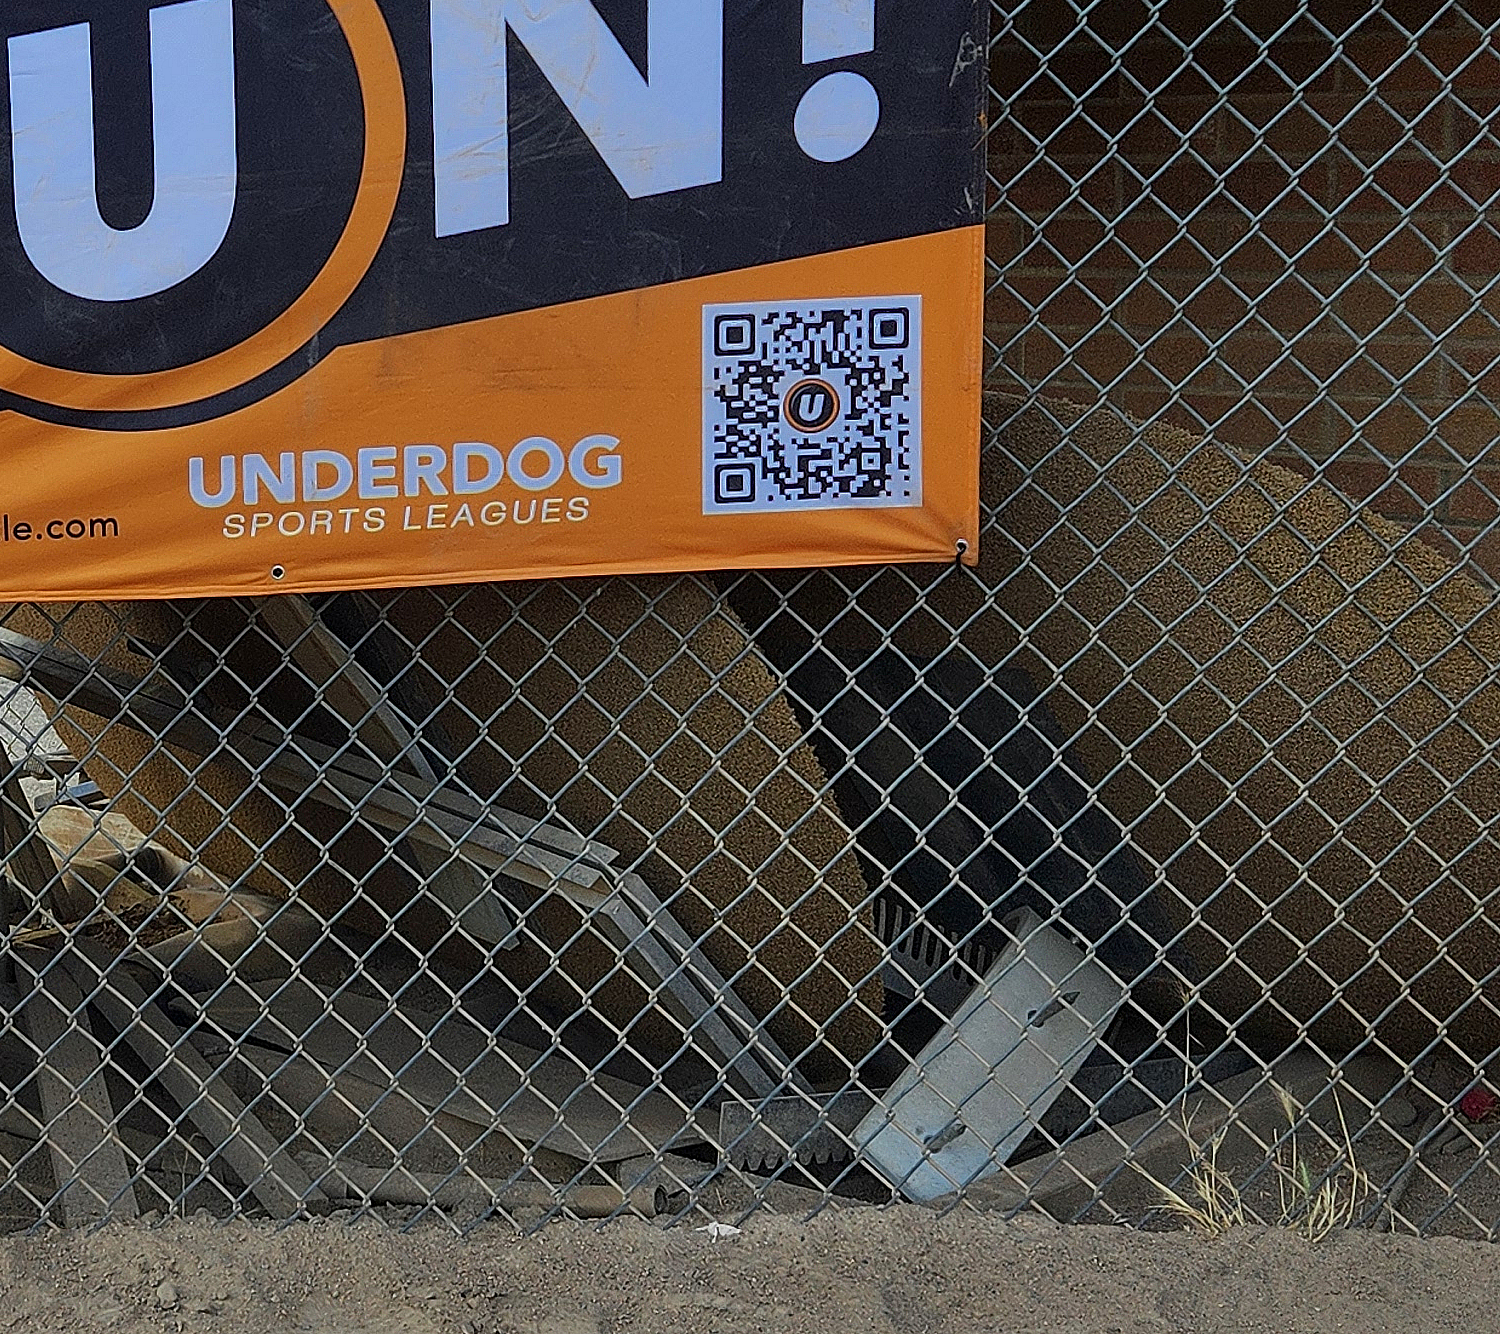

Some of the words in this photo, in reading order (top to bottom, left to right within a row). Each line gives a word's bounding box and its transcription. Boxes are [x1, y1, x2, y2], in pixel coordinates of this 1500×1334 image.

[799, 393, 825, 422] U
[188, 434, 623, 508] UNDERDOG
[222, 507, 387, 539] SPORTS
[402, 497, 591, 532] LEAGUES
